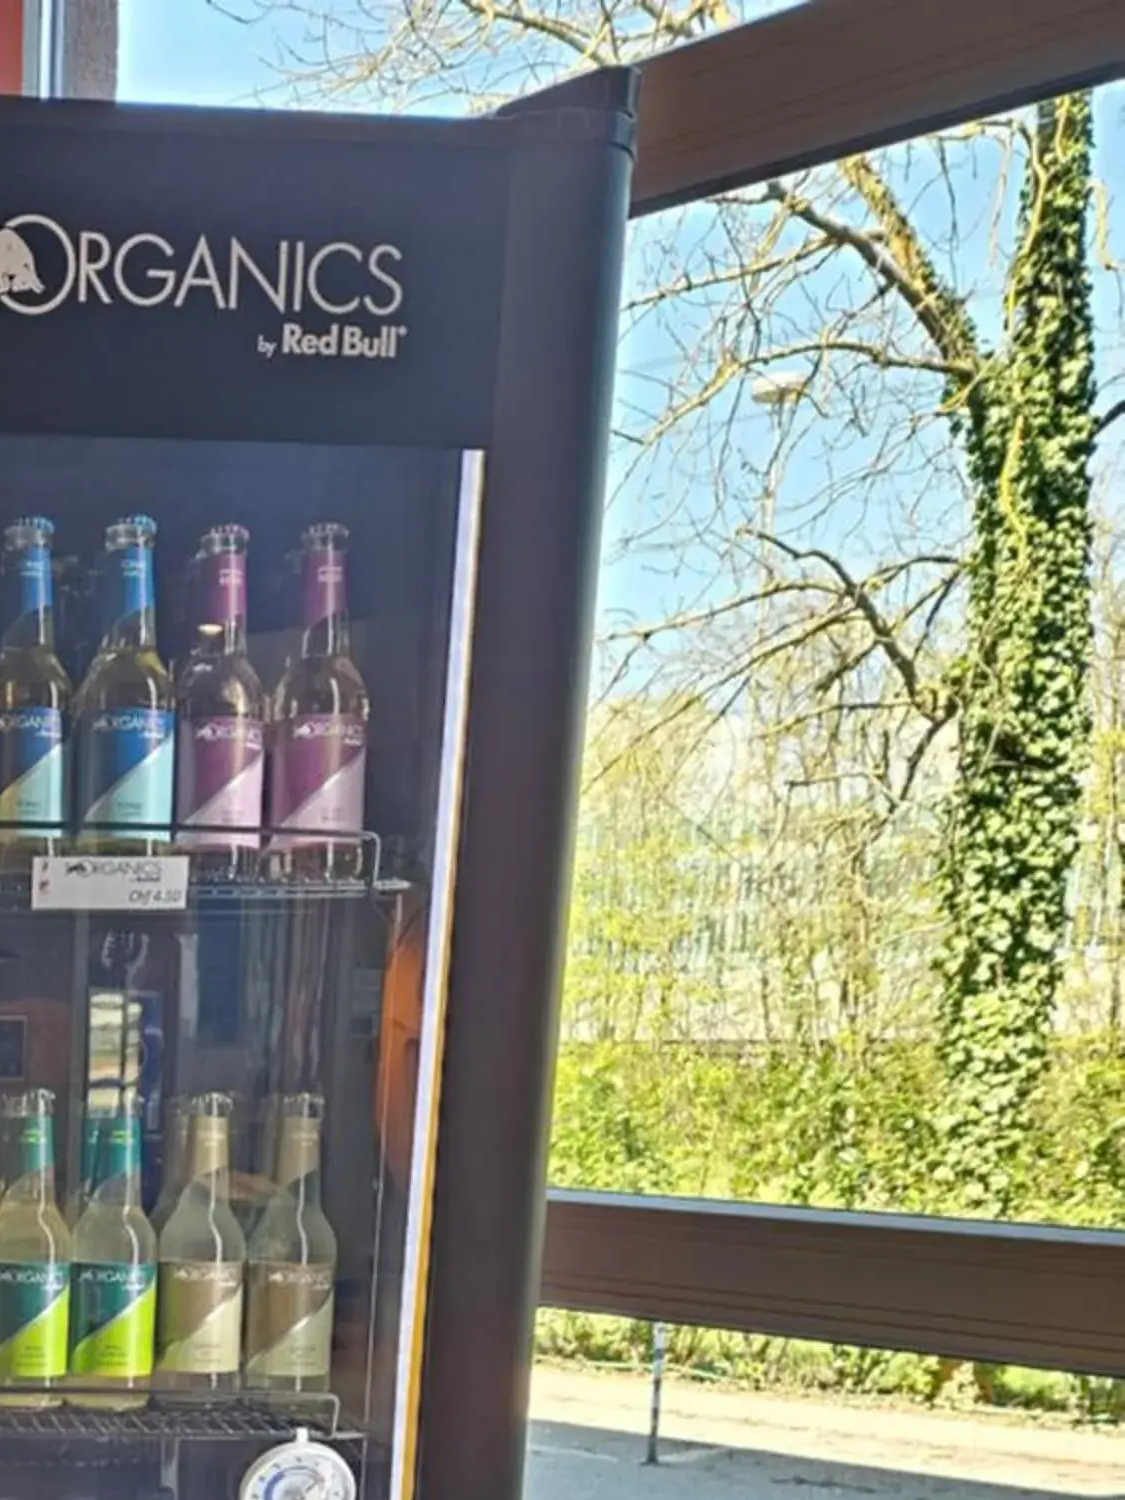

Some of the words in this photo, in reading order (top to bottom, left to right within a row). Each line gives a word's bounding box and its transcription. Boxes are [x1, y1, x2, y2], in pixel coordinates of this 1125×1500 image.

[256, 333, 277, 359] by
[281, 321, 340, 356] Red
[341, 324, 397, 358] Bull
